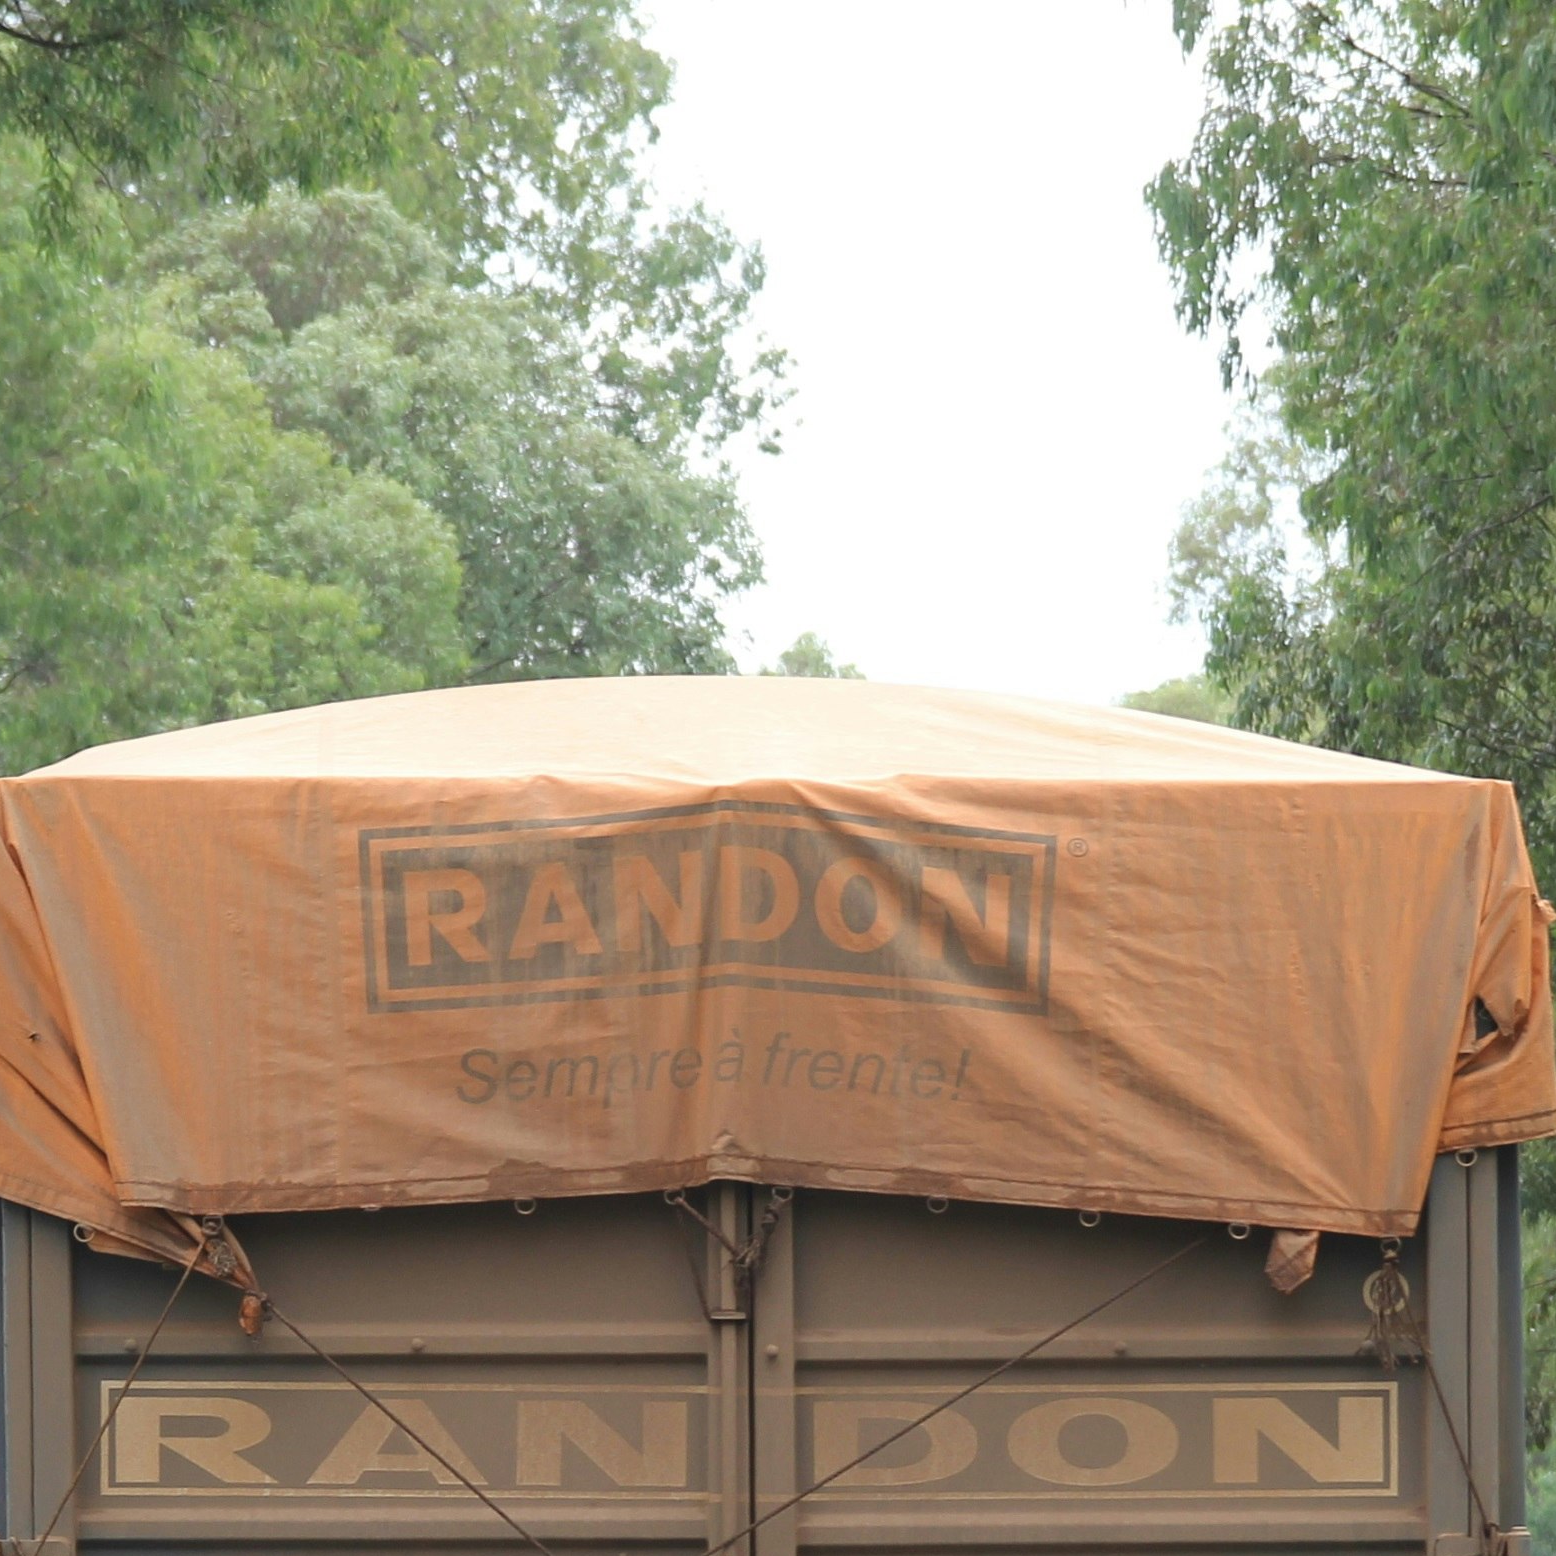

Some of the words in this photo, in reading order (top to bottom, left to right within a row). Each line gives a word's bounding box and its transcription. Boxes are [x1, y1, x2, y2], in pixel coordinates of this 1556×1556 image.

[402, 845, 1012, 968] RANDON
[455, 1046, 704, 1108] Sempre
[715, 1028, 745, 1082] à
[761, 1032, 972, 1102] frente!
